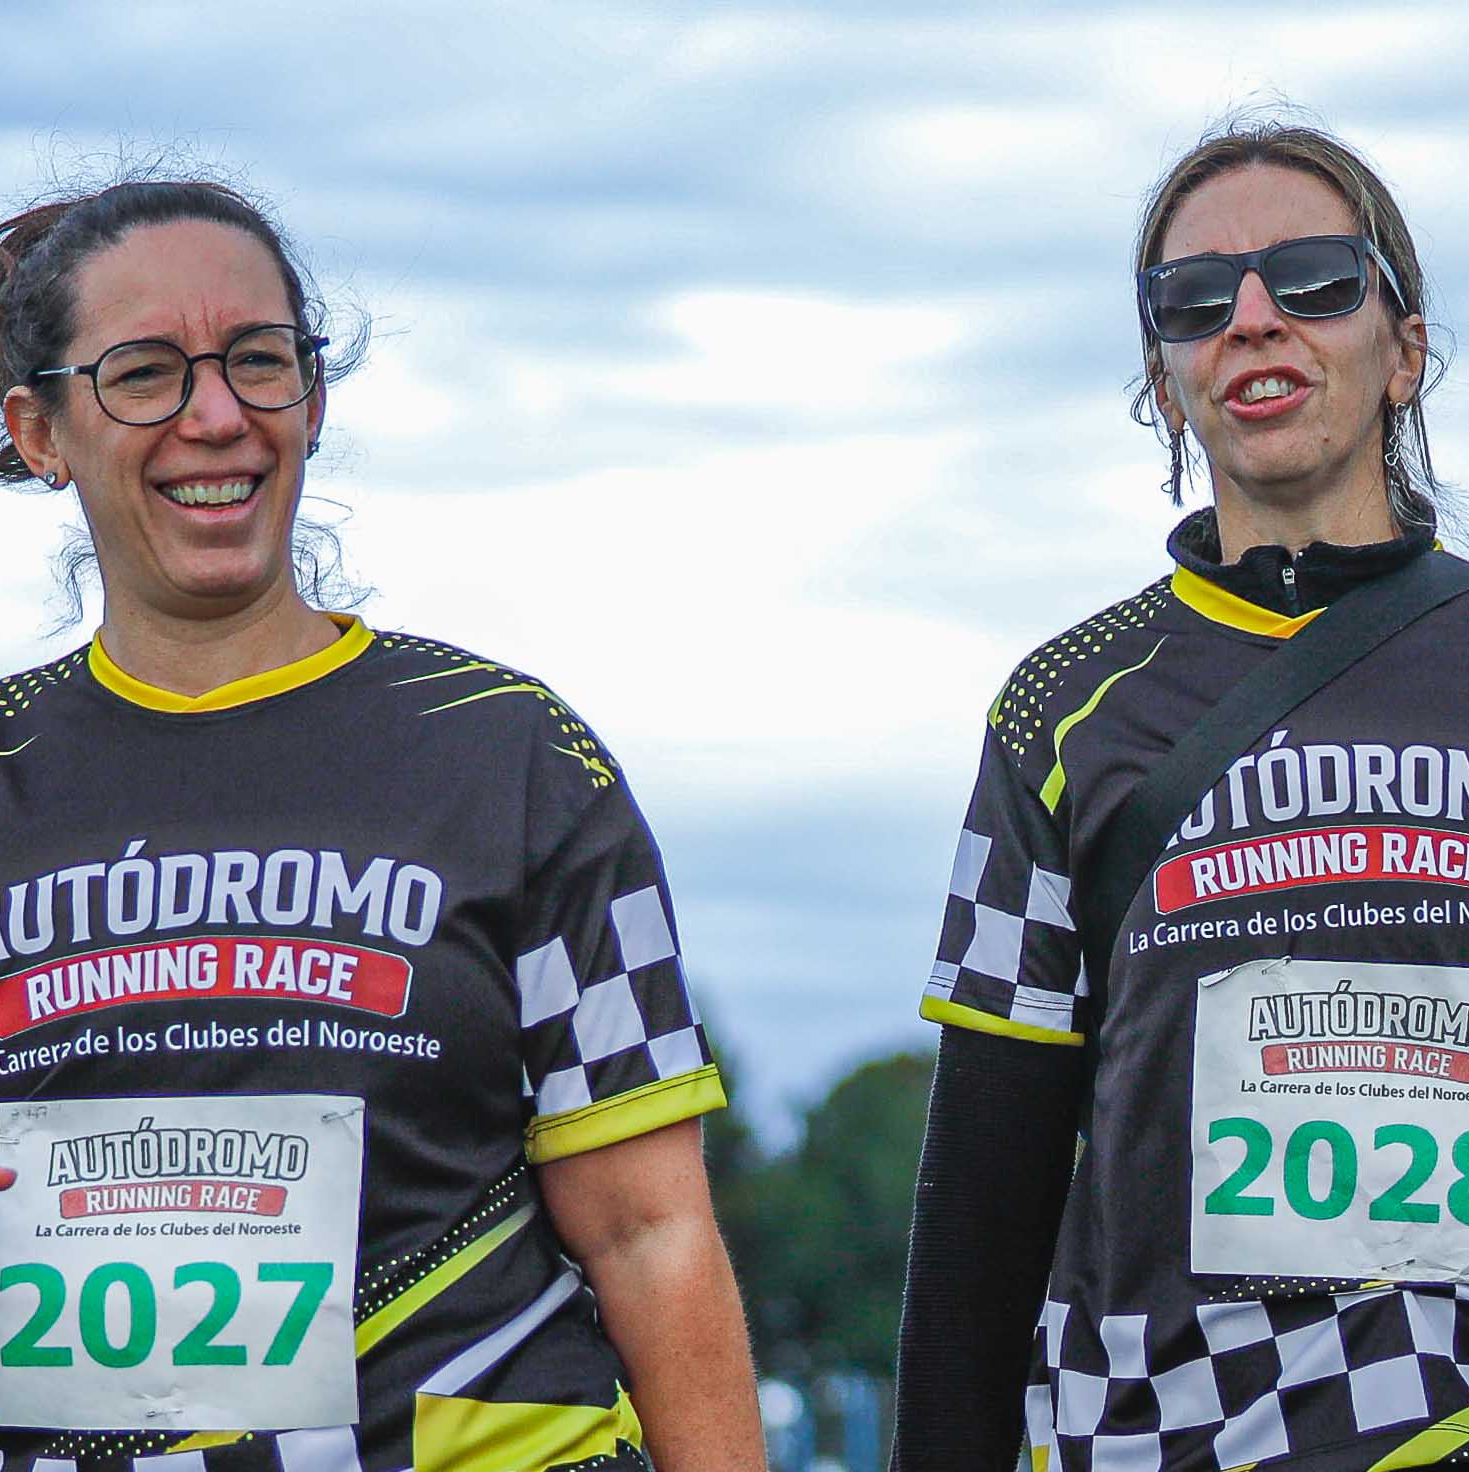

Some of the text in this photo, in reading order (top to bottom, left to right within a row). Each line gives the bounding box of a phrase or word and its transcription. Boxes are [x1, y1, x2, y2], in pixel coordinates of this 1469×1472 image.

[1191, 832, 1368, 898] RUNNING
[1129, 931, 1148, 955] La
[1152, 919, 1239, 947] Carrera
[1247, 911, 1275, 936] de
[1283, 908, 1316, 932] los
[1323, 901, 1405, 928] Clubes
[1413, 899, 1452, 925] del
[26, 943, 358, 1021] RUNNING RACE
[74, 1028, 110, 1056] de
[118, 1026, 157, 1053] los
[165, 1019, 259, 1050] Clubes
[267, 1018, 309, 1047] del
[318, 1021, 441, 1060] Noroeste
[1286, 1045, 1453, 1077] RUNNING RACE
[1241, 1079, 1256, 1094] La
[1260, 1080, 1311, 1095] Carrera
[1314, 1081, 1332, 1096] de
[1336, 1082, 1356, 1097] los
[1359, 1083, 1405, 1099] Clubes
[1408, 1085, 1429, 1100] del
[47, 1117, 310, 1186] AUTÓDROMO
[86, 1184, 262, 1214] RUNNING RACE
[35, 1221, 302, 1237] La Carrera de los Clubes del Noroeste
[0, 1261, 334, 1368] 2027
